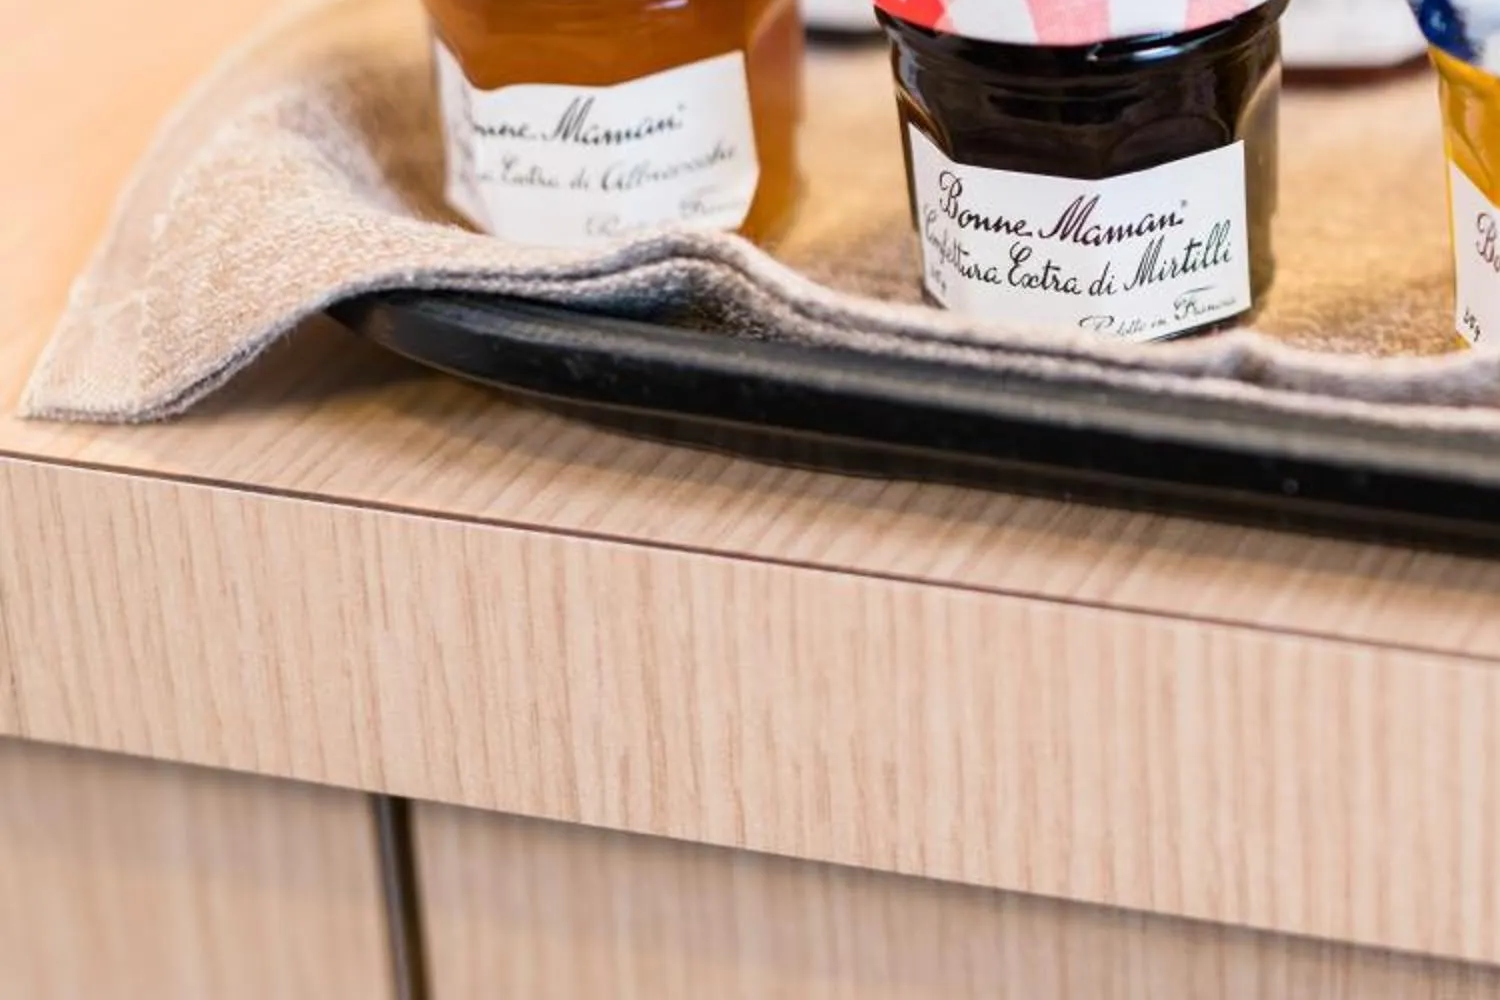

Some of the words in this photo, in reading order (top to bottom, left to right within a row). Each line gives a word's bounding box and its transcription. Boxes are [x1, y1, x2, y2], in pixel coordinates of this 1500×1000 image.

[542, 96, 683, 146] Maman
[939, 170, 1033, 237] Bonne
[1037, 194, 1185, 247] Maman
[1007, 240, 1082, 296] Extra
[1088, 260, 1116, 297] di
[1123, 218, 1233, 290] Mirtilli
